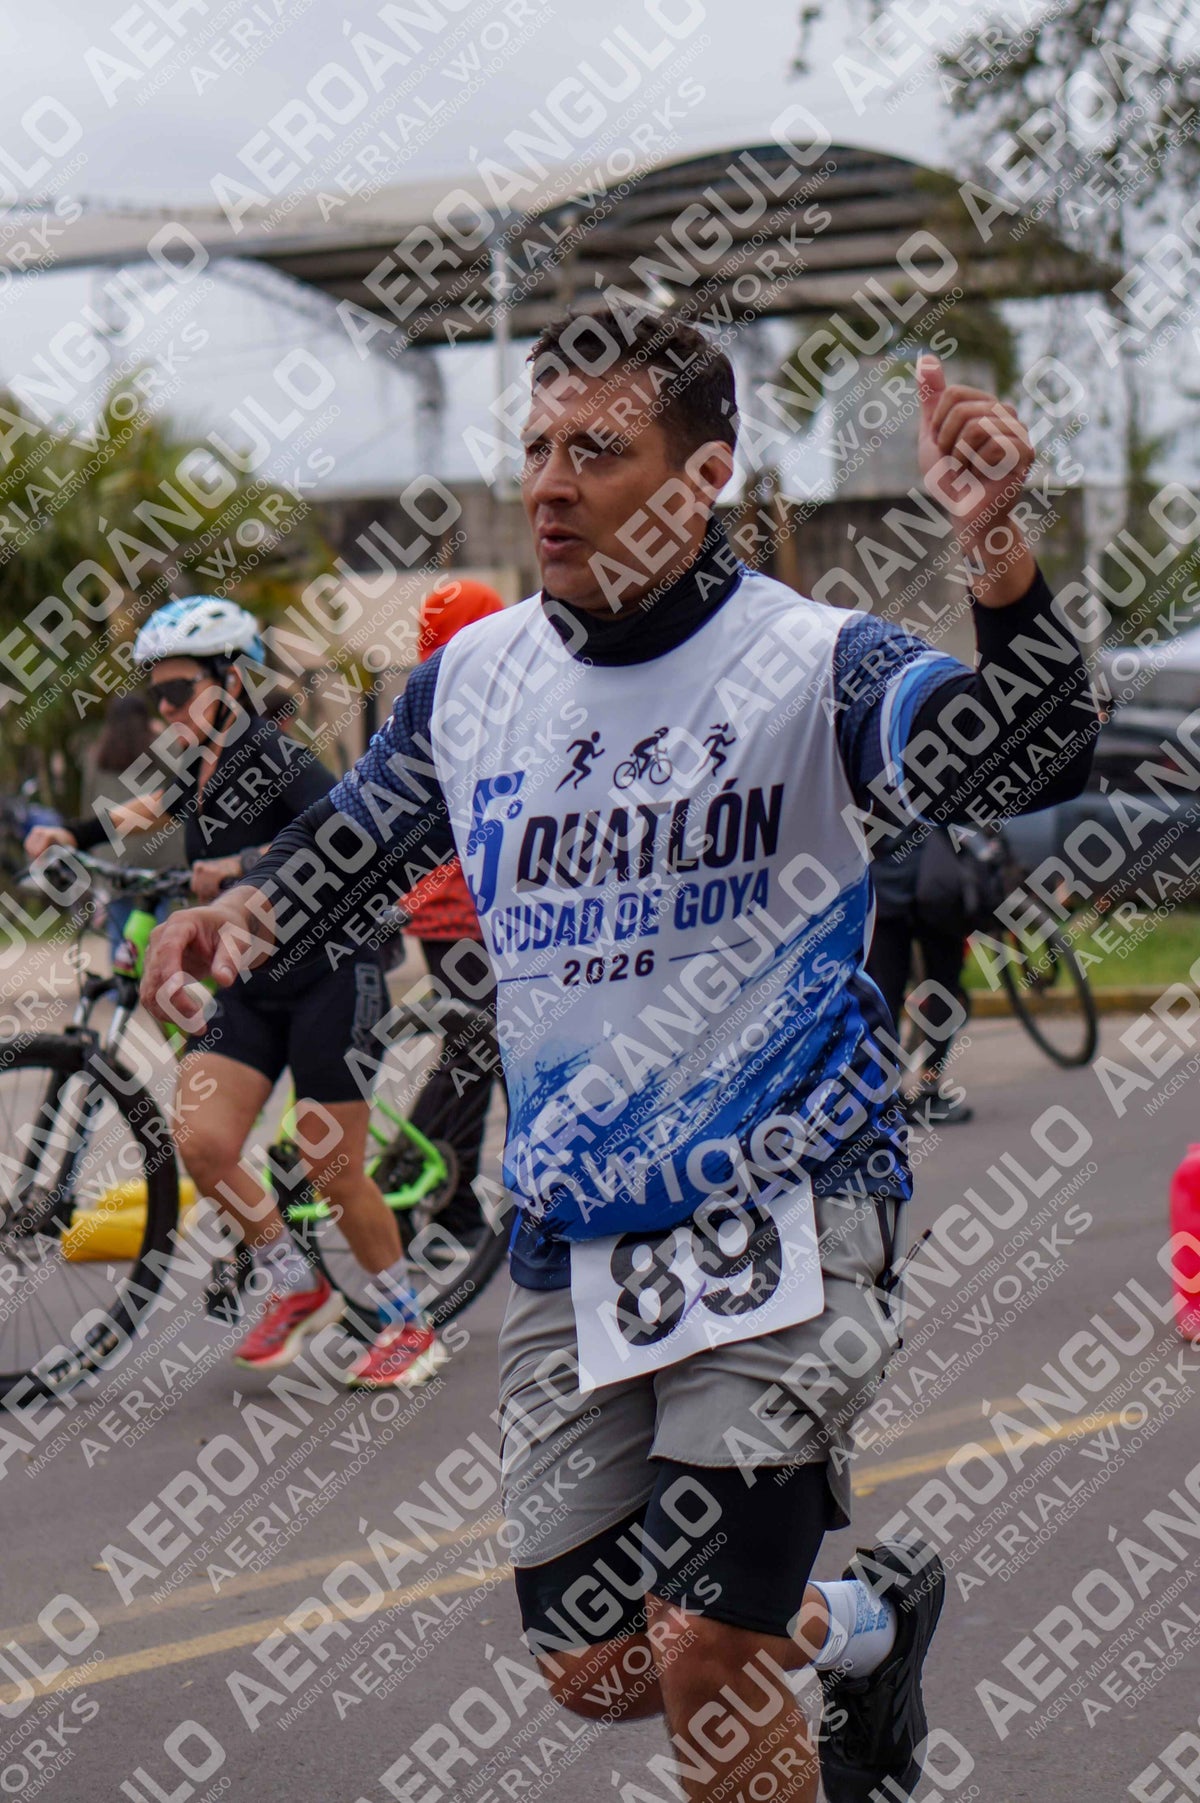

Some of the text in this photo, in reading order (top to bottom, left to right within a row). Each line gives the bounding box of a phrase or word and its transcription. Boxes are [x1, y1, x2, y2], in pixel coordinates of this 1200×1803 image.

[515, 778, 785, 894] DUATLÓN
[491, 868, 769, 956] CIUDAD DE GOYA
[563, 950, 655, 987] 2026
[610, 1207, 783, 1346] 89
